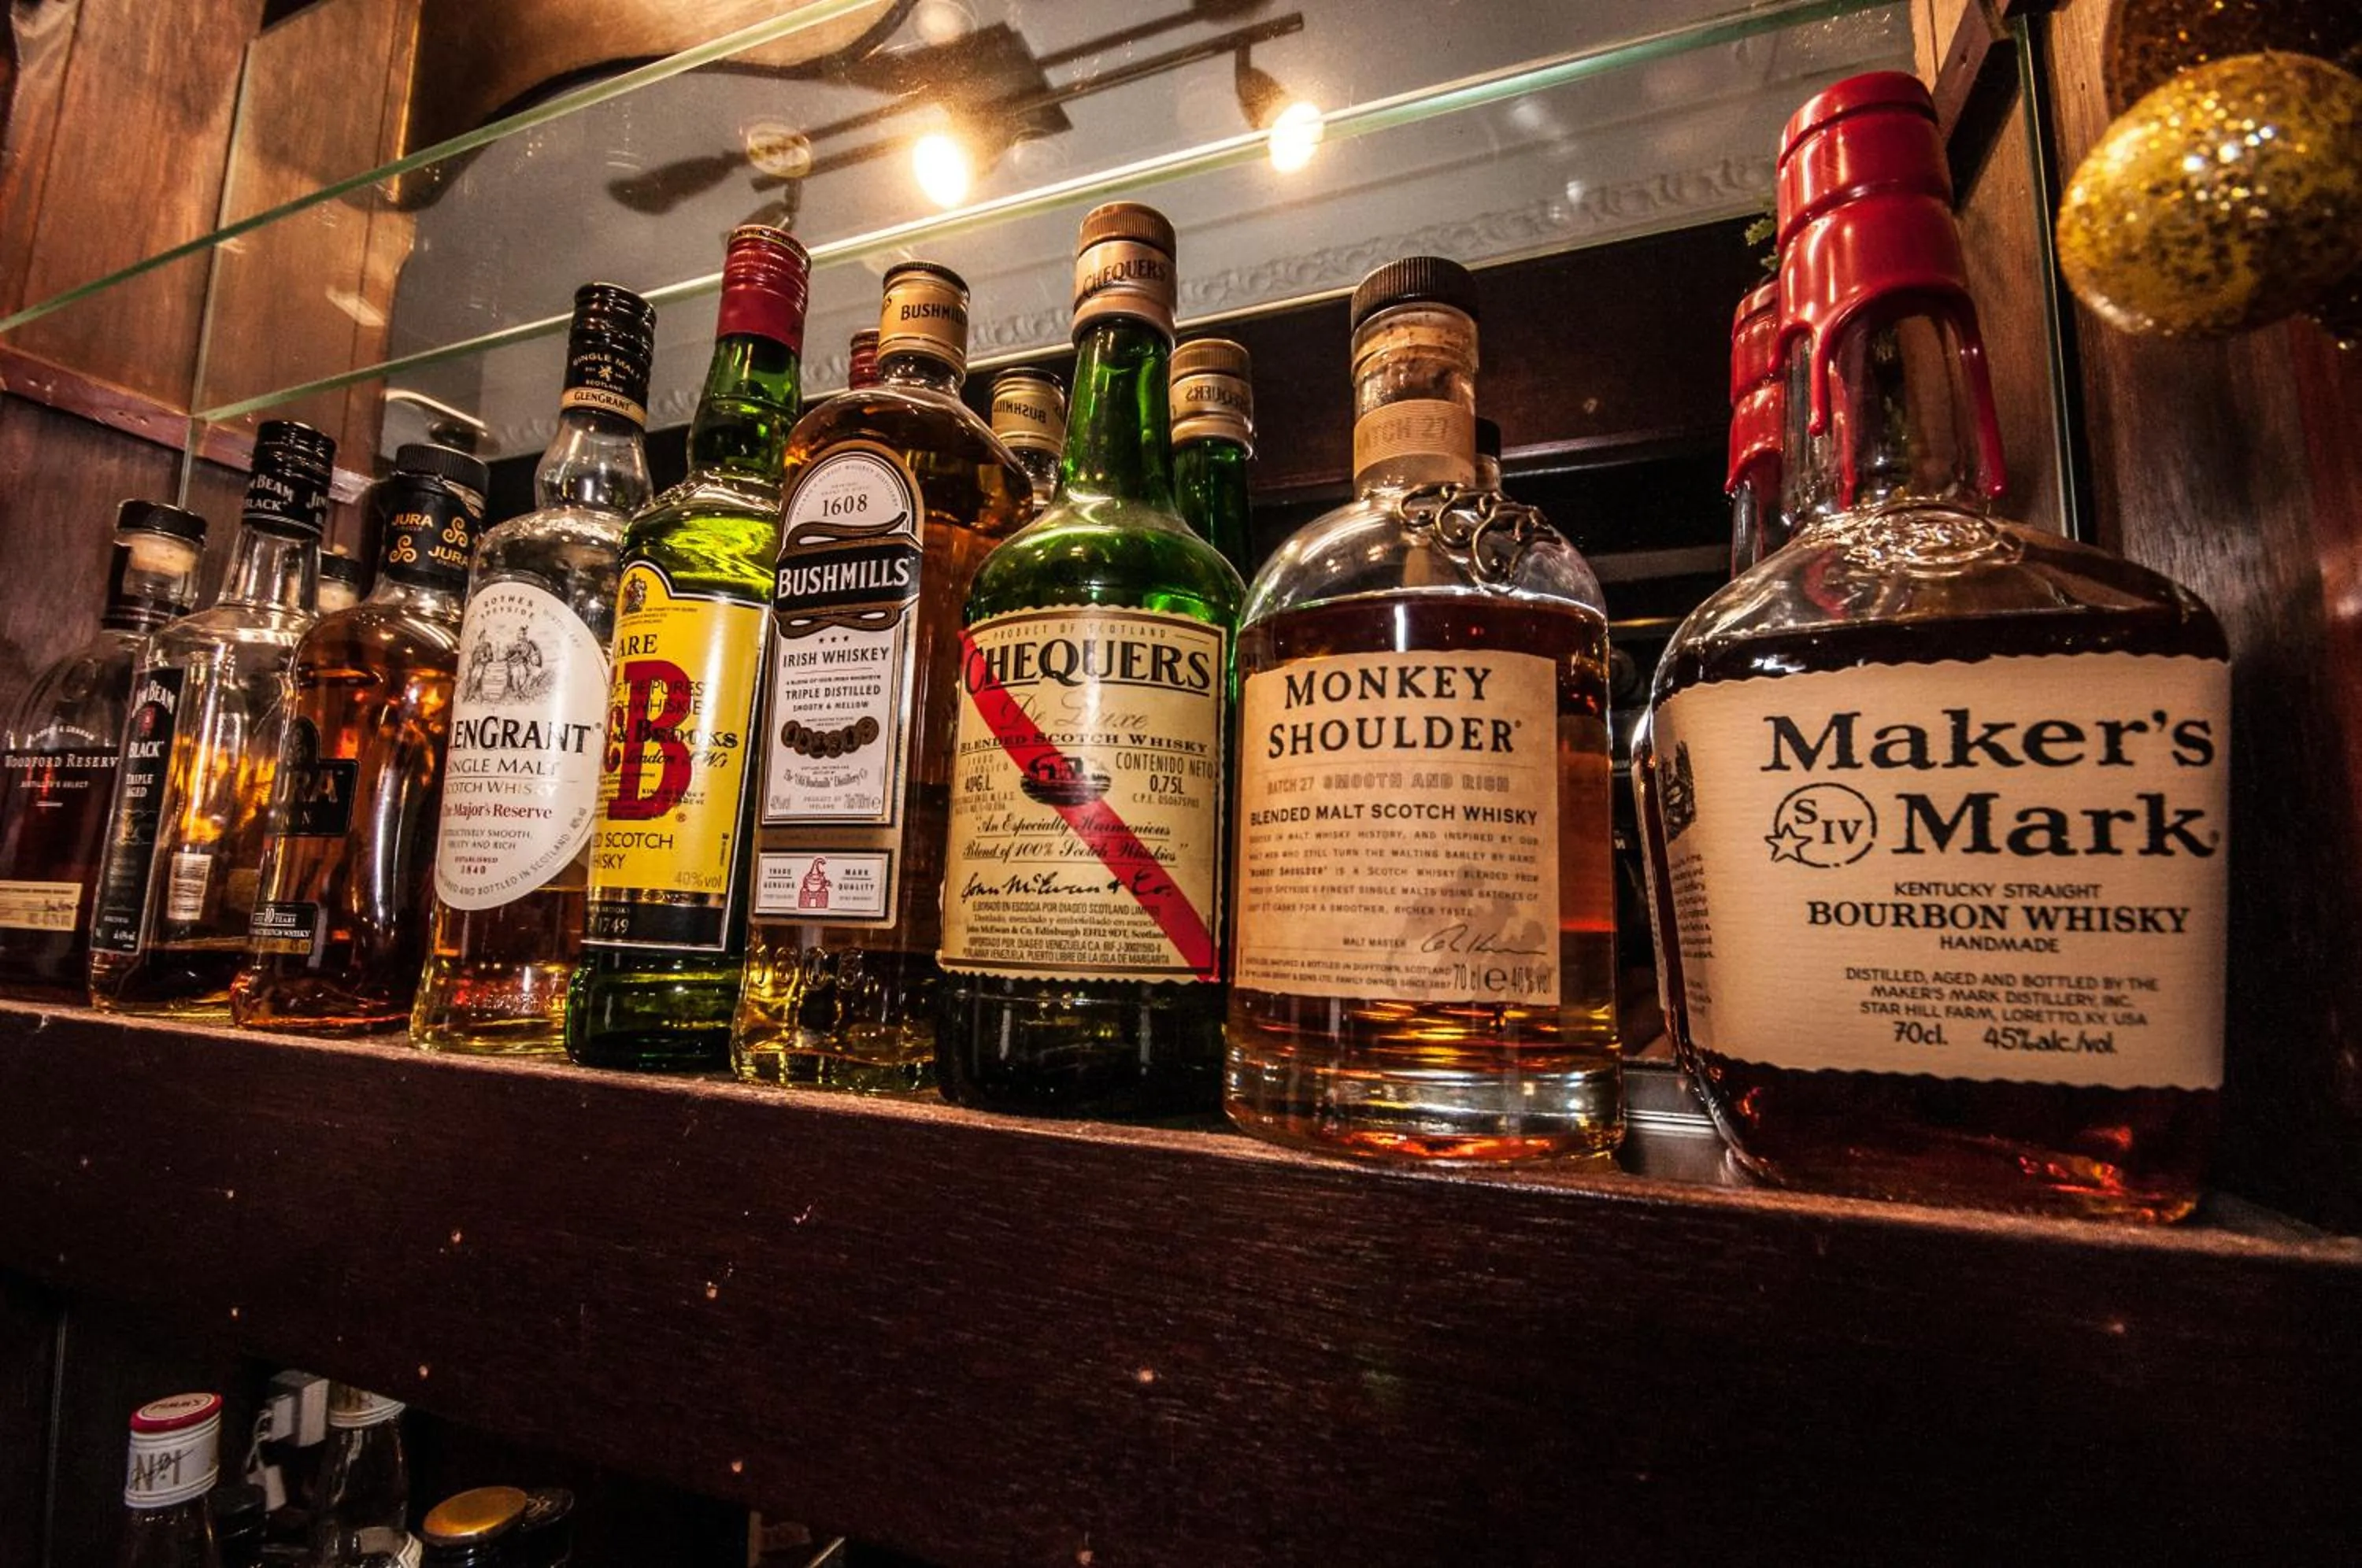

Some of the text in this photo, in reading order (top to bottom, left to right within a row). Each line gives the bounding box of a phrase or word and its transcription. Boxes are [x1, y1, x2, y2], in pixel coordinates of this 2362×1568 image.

[1083, 260, 1166, 298] CHEQUERS
[574, 392, 631, 412] GLENGRANT
[257, 474, 294, 504] BEAM
[822, 494, 868, 517] 1608
[392, 512, 433, 528] JURA
[428, 545, 468, 568] JURA
[776, 557, 911, 600] BUSHMILLS
[994, 623, 1047, 640] PRODUCT
[616, 634, 658, 659] ARE
[783, 646, 891, 668] IRISH WHISKEY
[964, 638, 1211, 696] CHEQUERS
[148, 680, 176, 715] BEAM
[651, 679, 707, 697] PURES
[786, 684, 882, 701] TRIPLE DISTILLED
[1284, 665, 1493, 710] MONKEY
[450, 715, 591, 753] ENGRANT
[960, 731, 1209, 754] BLENDED SCOTCH WHISKY
[1268, 715, 1515, 760] SHOULDER
[1760, 707, 2216, 773] Maker's
[5, 753, 119, 768] WOODFORD RESERV
[128, 741, 160, 759] BLACK
[1116, 752, 1214, 781] CONTENIDO NETO
[1300, 776, 1316, 791] 27
[1323, 772, 1403, 790] SMOOTH
[1411, 771, 1454, 790] AND
[1461, 775, 1511, 794] RICH
[454, 803, 491, 820] Major's
[493, 803, 553, 819] Reserve
[1250, 803, 1538, 826] BLENDED MALT SCOTCH WHISKY
[1001, 812, 1070, 837] Especially
[1890, 790, 2216, 859] Mark
[605, 831, 674, 849] SCOTCH
[962, 839, 999, 858] Blend
[1015, 841, 1054, 858] 100%
[1315, 830, 1351, 840] WHISKY
[1414, 830, 1437, 840] AND
[1444, 831, 1494, 843] INSPIRED
[1500, 835, 1513, 844] BY
[1519, 836, 1539, 846] OUR
[1304, 849, 1328, 857] STILL
[1333, 849, 1360, 857] TURN
[1366, 849, 1385, 857] THE
[1391, 849, 1439, 858] MALTING
[1445, 850, 1486, 860] BARLEY
[1368, 867, 1407, 876] SCOTCH
[1417, 868, 1456, 878] WHISKY
[838, 882, 876, 893] QUALITY
[1894, 881, 2104, 899] KENTUCKY STRAIGHT
[598, 917, 629, 934] 1749
[1806, 900, 2191, 934] BOURBON WHISKY
[1342, 937, 1406, 948] MALT MASTER
[1939, 934, 2060, 954] HANDMADE
[1845, 966, 2160, 993] DISTILLED, AGED AND BOTTLED BY THE
[1870, 985, 1946, 1002] MAKER'S
[1949, 989, 2001, 1004] MARK
[1860, 1000, 1901, 1015] STAR
[1904, 1003, 1942, 1019] HILL
[2113, 1011, 2149, 1026] USA
